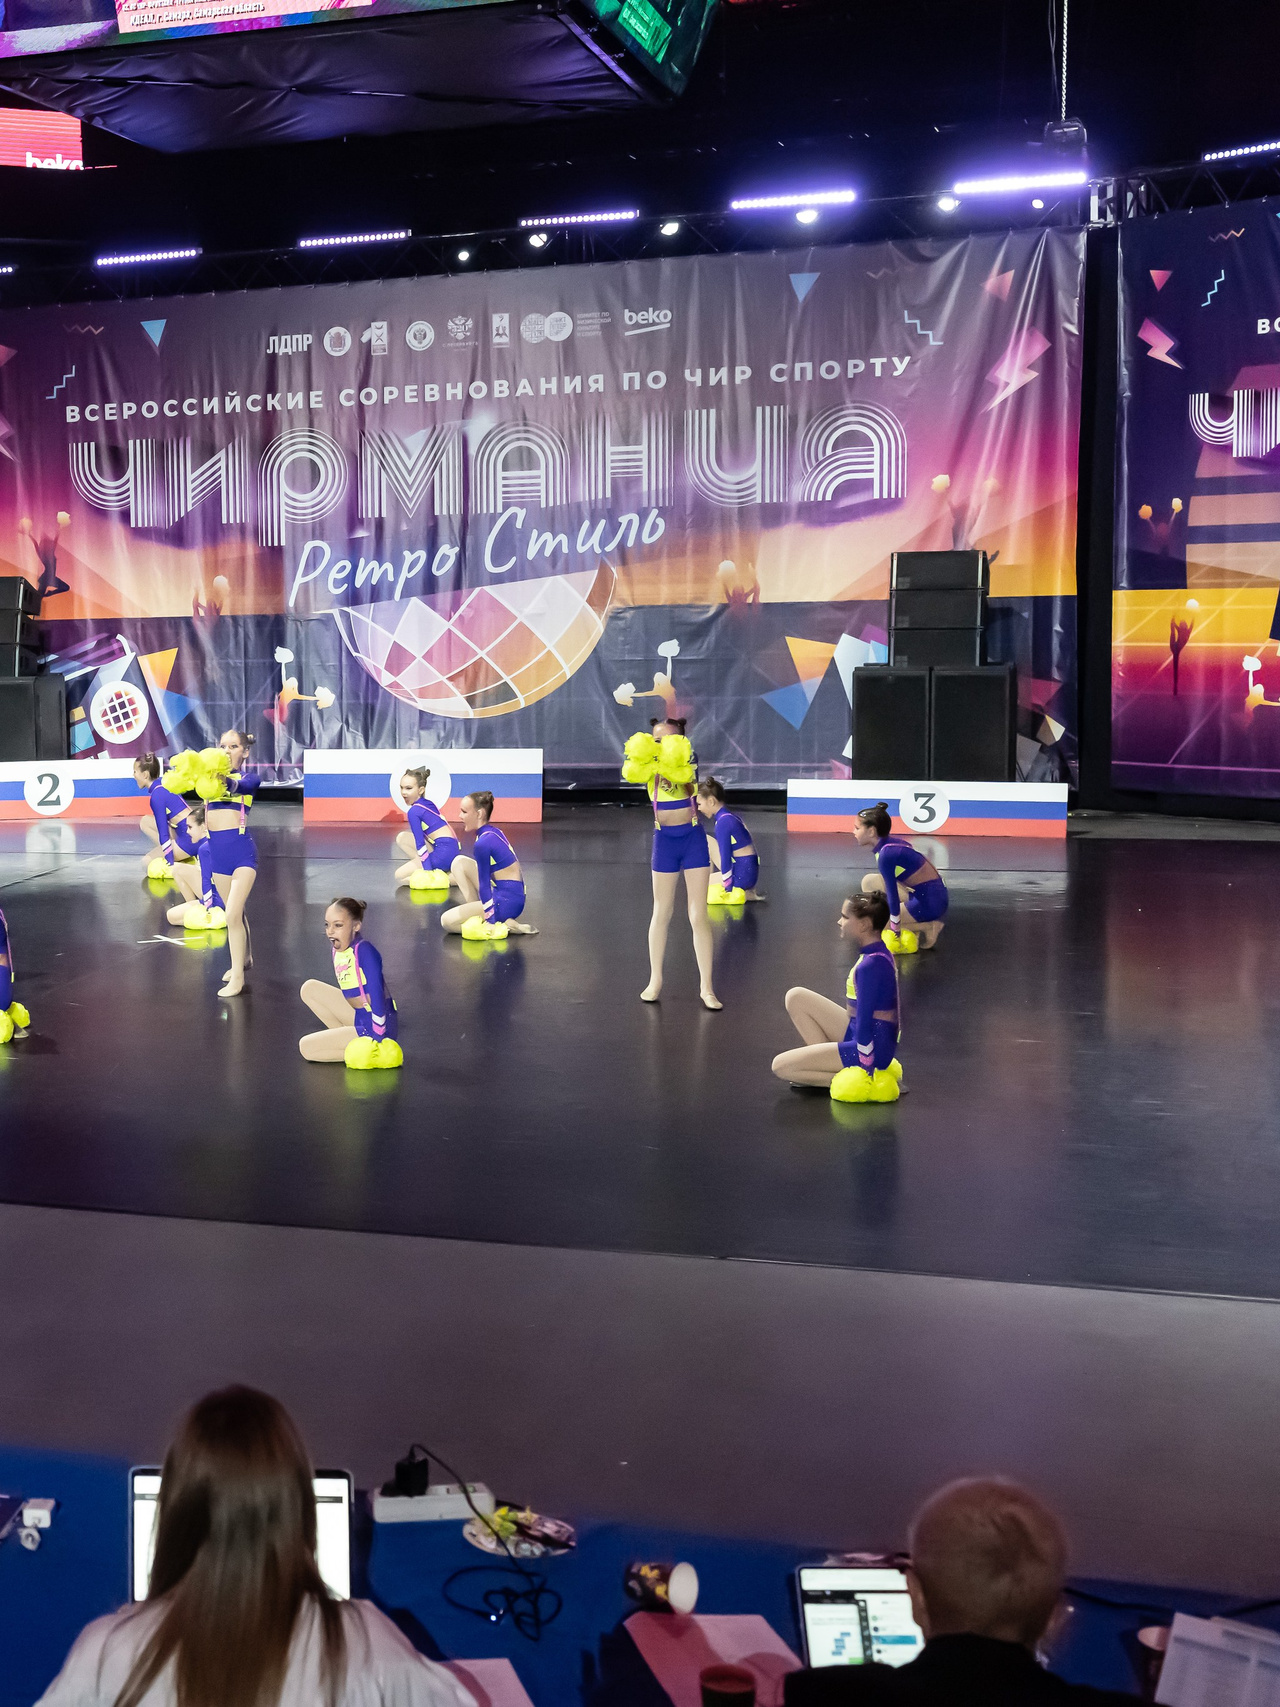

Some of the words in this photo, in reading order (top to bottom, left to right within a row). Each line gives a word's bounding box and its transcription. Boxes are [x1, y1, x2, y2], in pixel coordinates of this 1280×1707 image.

[624, 307, 672, 325] beko
[266, 333, 313, 356] ЛДПР
[66, 390, 324, 423] ВСЕРОССИЙСКИЕ
[339, 373, 604, 407] СОРЕВНОВАНИЯ
[623, 370, 667, 391] ПО
[684, 365, 753, 387] ЧИР
[770, 355, 912, 383] СПОРТУ
[288, 540, 461, 607] Ретро
[484, 507, 666, 573] Стиль
[36, 772, 61, 807] 2
[912, 792, 937, 823] 3
